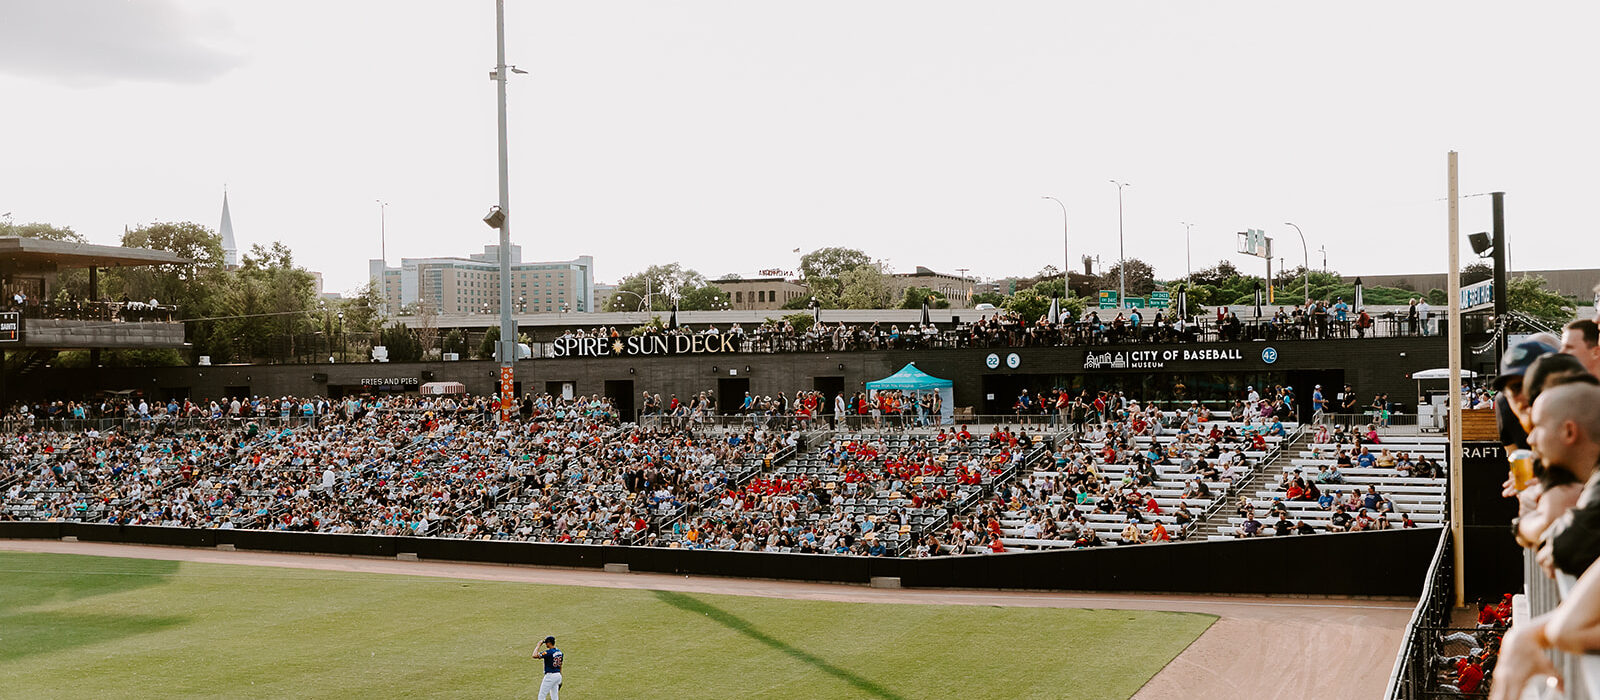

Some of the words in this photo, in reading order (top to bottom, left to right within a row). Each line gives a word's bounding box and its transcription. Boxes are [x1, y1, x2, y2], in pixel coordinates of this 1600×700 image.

[554, 337, 610, 357] SPIRE
[627, 335, 669, 355] SUN
[675, 333, 736, 354] DECK
[1131, 350, 1158, 361] CITY
[1163, 350, 1179, 361] OF
[1183, 349, 1243, 360] BASEBALL
[1263, 351, 1276, 360] 42
[988, 357, 998, 366] 22
[1010, 357, 1017, 365] 5
[361, 378, 383, 386] FRIES
[400, 377, 418, 385] PIES
